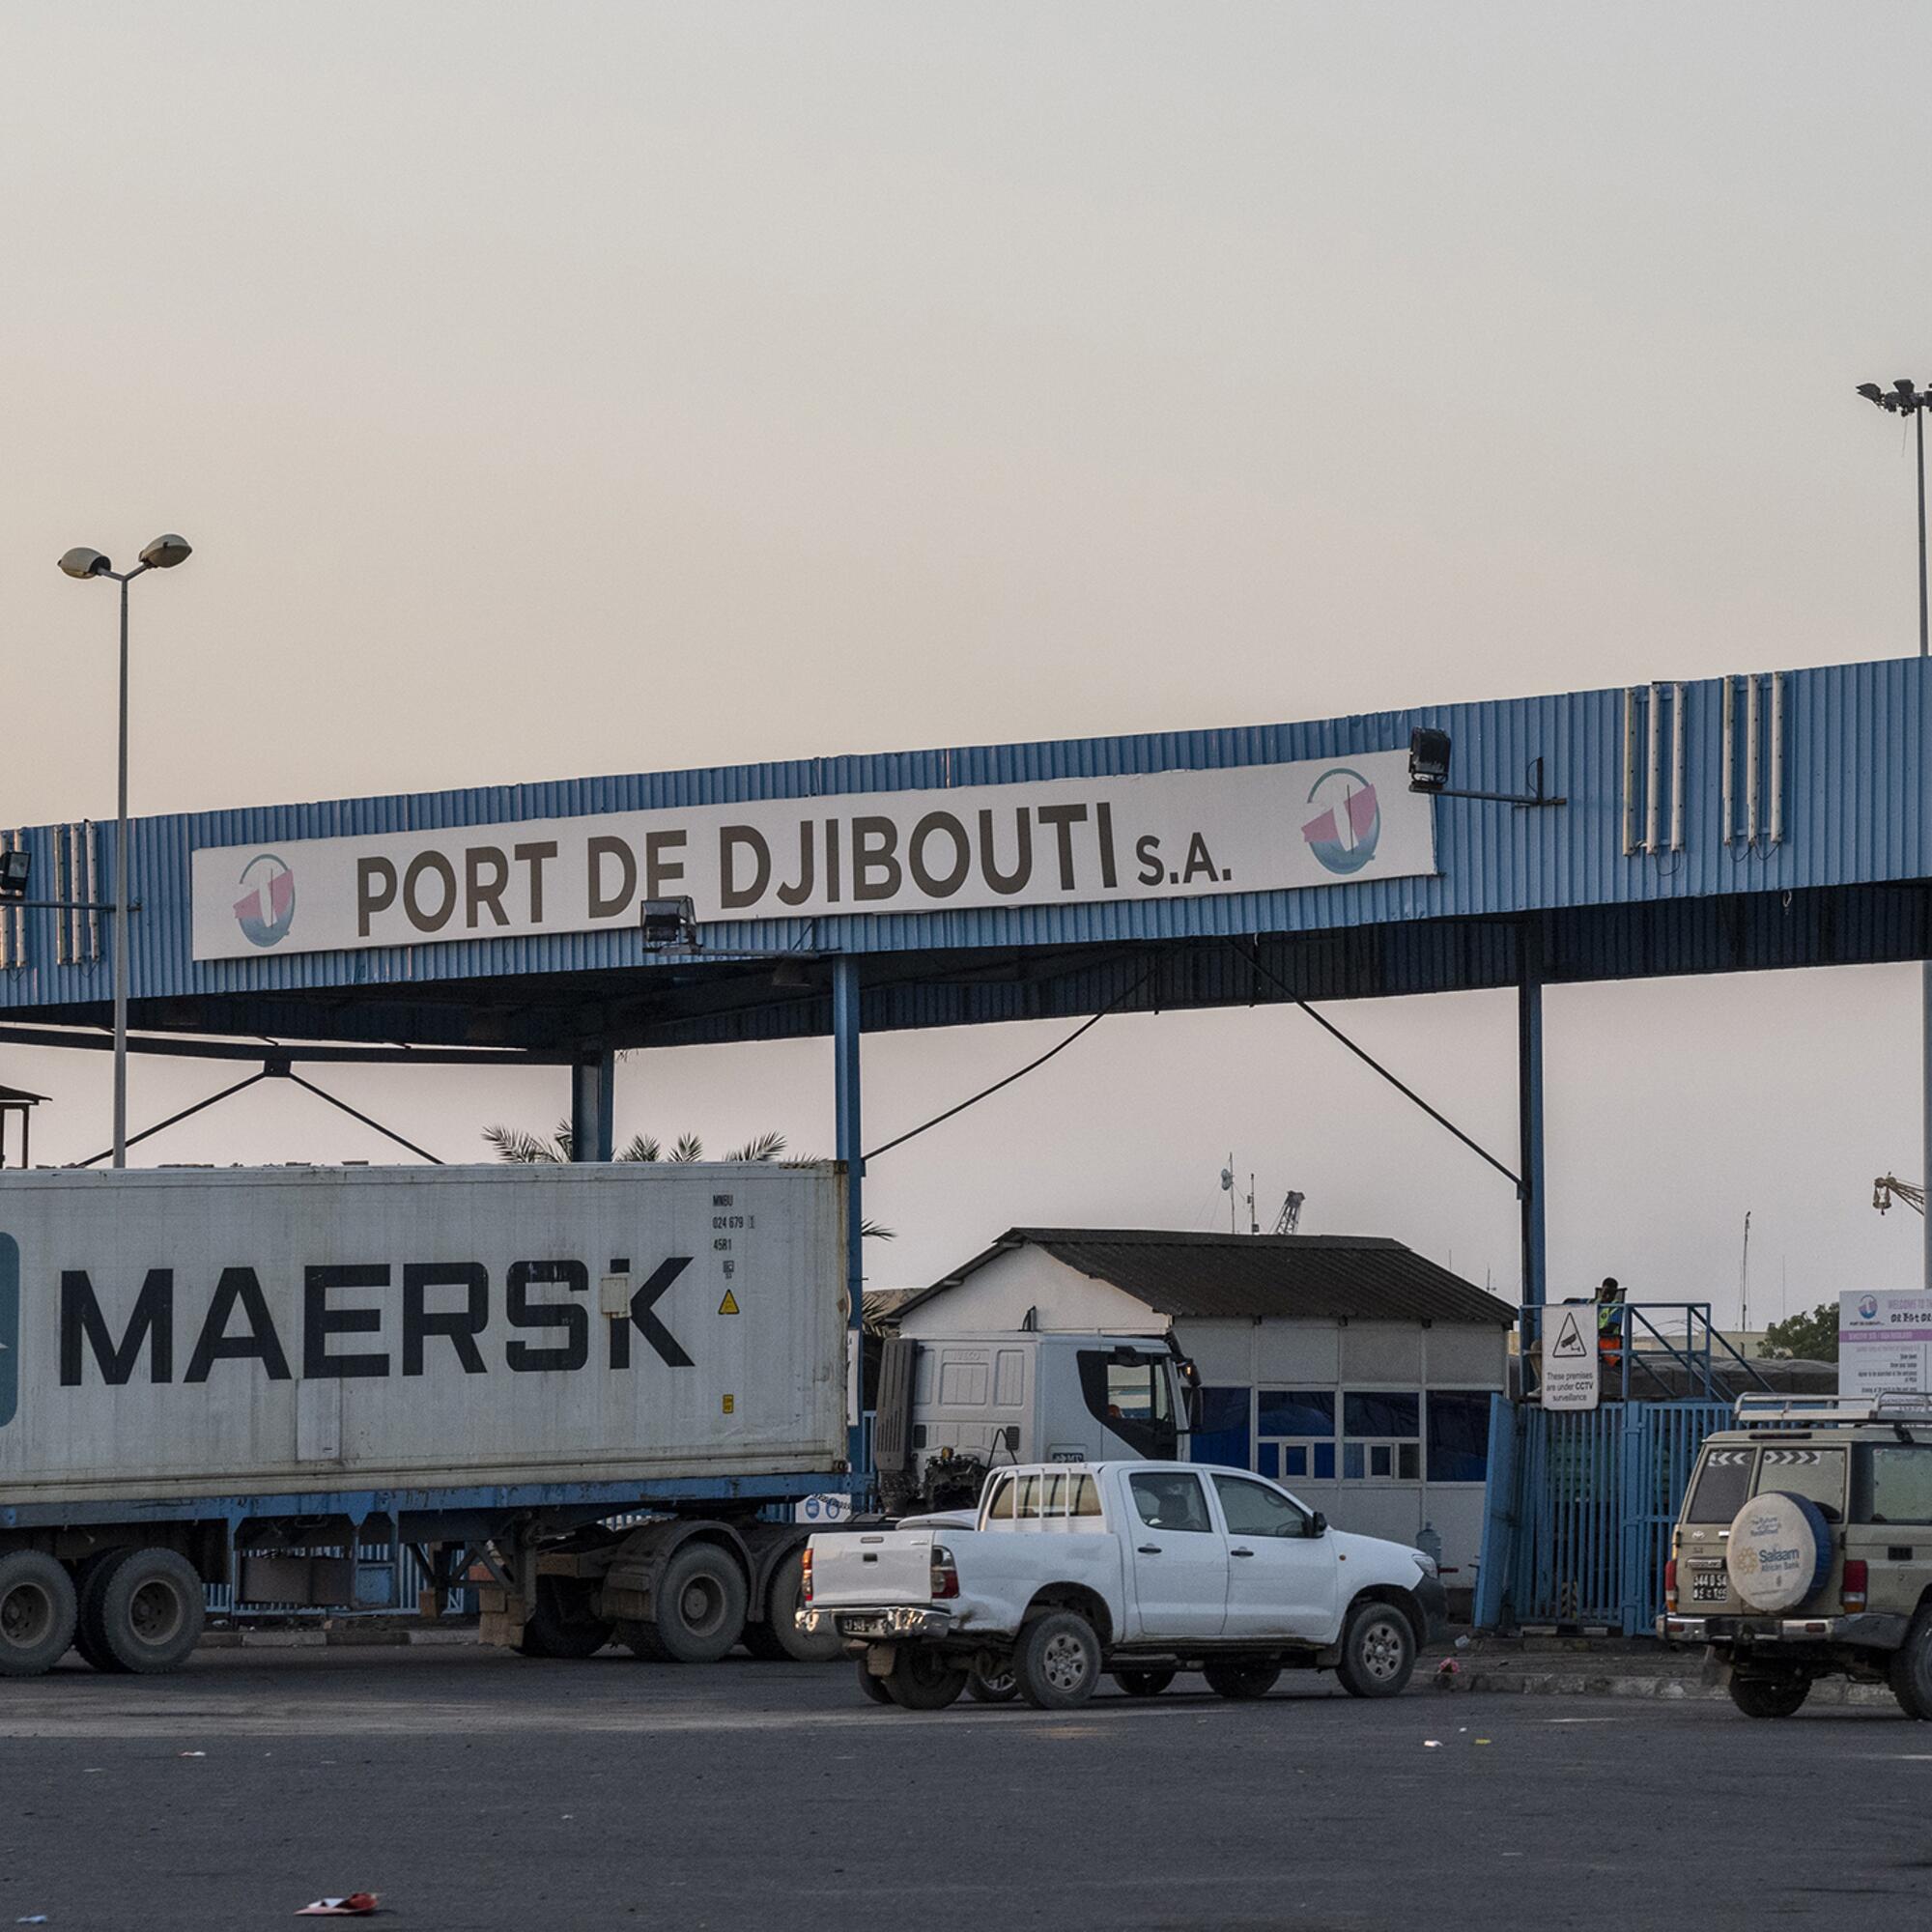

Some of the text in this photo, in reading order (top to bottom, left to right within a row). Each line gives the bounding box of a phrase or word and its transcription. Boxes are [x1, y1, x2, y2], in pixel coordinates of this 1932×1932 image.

[357, 802, 1232, 937] PORT DE DJIBOUTI S.A.
[712, 1216, 727, 1229] 024
[728, 1216, 744, 1229] 679
[61, 1257, 695, 1386] MAERSK
[1548, 1372, 1593, 1381] These premises
[1557, 1382, 1575, 1391] under
[1575, 1381, 1594, 1390] CCTV
[1552, 1393, 1587, 1403] surveillance
[1758, 1548, 1800, 1563] Salaam
